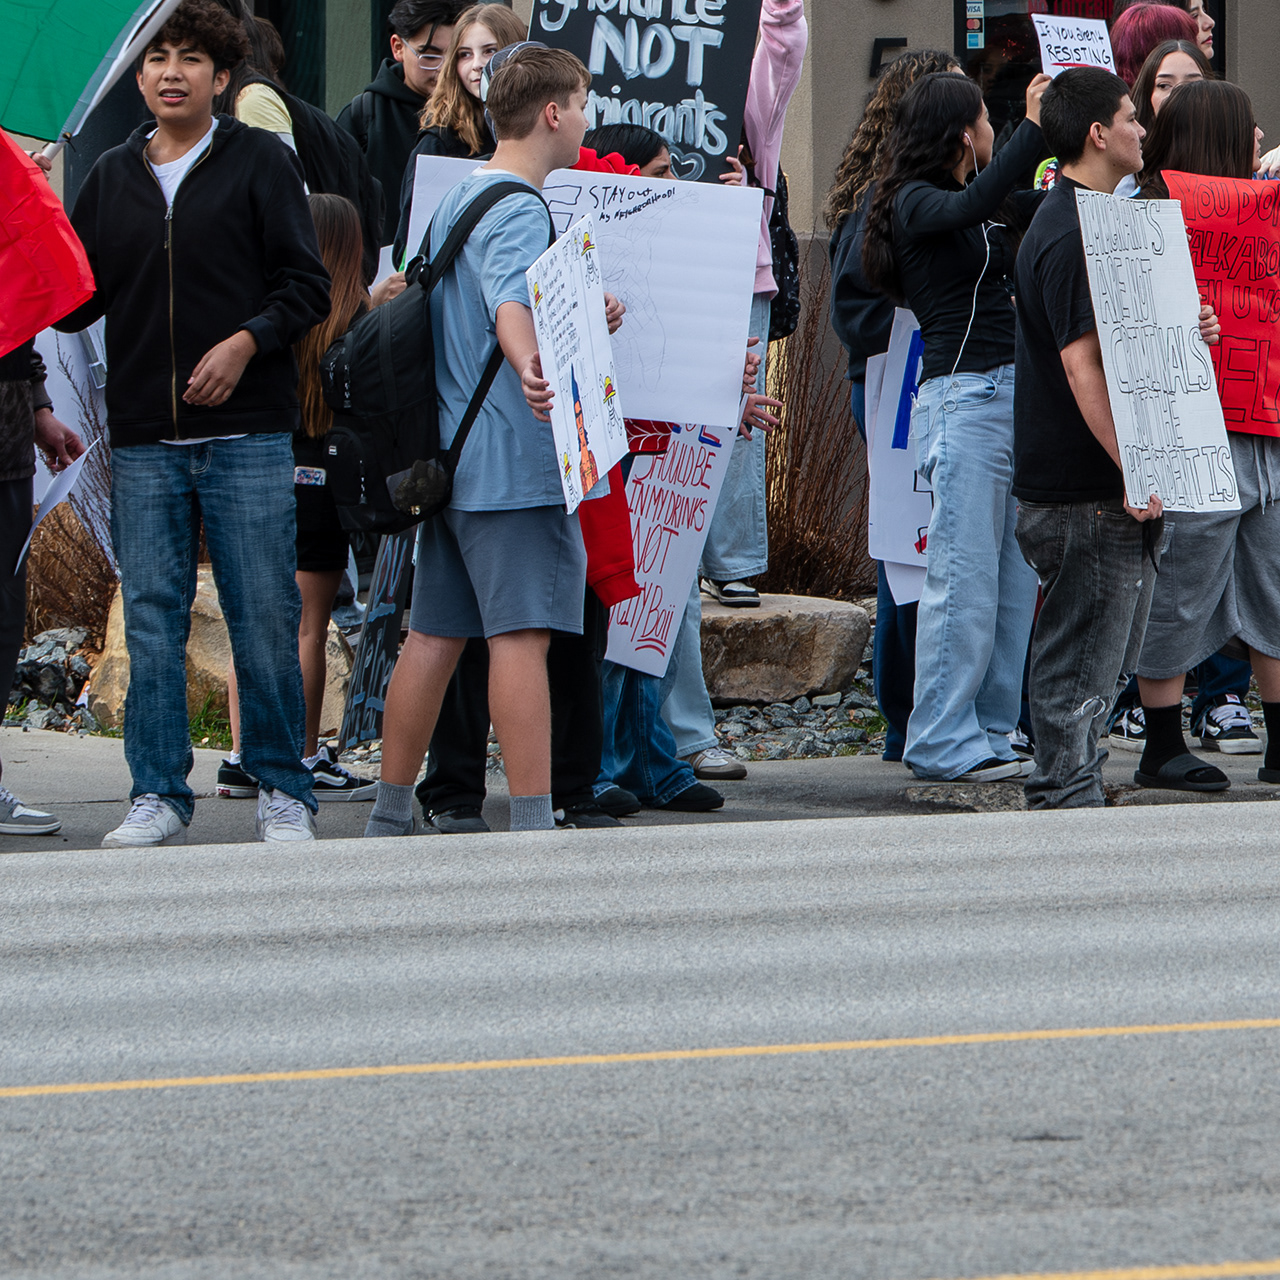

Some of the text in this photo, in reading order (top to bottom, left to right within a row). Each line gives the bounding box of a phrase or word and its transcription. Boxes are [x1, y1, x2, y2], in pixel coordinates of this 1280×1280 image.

[588, 15, 724, 87] NOT
[1046, 43, 1112, 67] RESISTING
[589, 185, 652, 209] STAY out
[1171, 174, 1231, 221] YOU
[1232, 285, 1251, 319] U
[691, 445, 716, 490] BE
[1202, 445, 1237, 504] IS
[645, 487, 668, 524] MY
[664, 490, 708, 532] DRINKS
[633, 517, 679, 574] NOT
